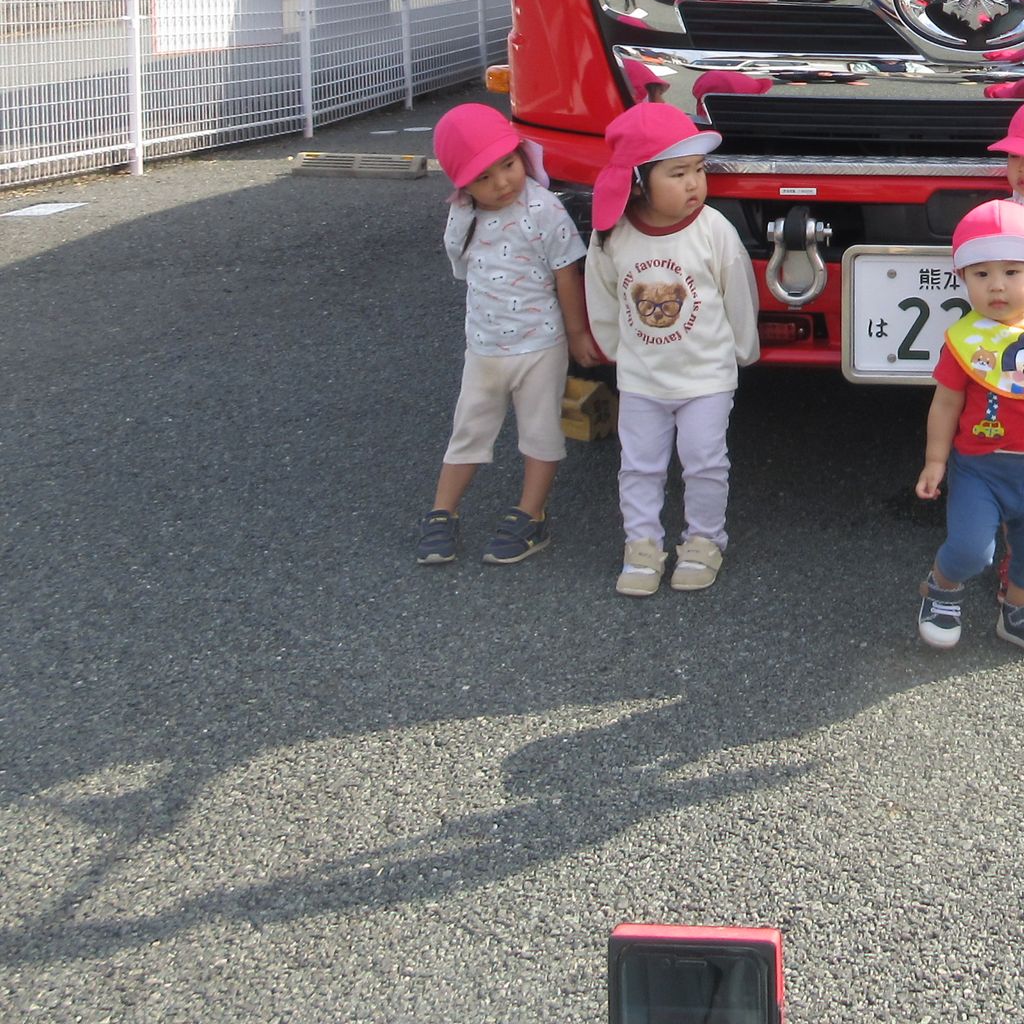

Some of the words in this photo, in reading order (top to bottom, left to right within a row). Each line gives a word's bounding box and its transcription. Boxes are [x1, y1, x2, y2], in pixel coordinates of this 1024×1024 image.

[622, 271, 634, 290] my
[685, 275, 698, 299] this
[683, 314, 697, 333] my
[867, 317, 889, 339] は
